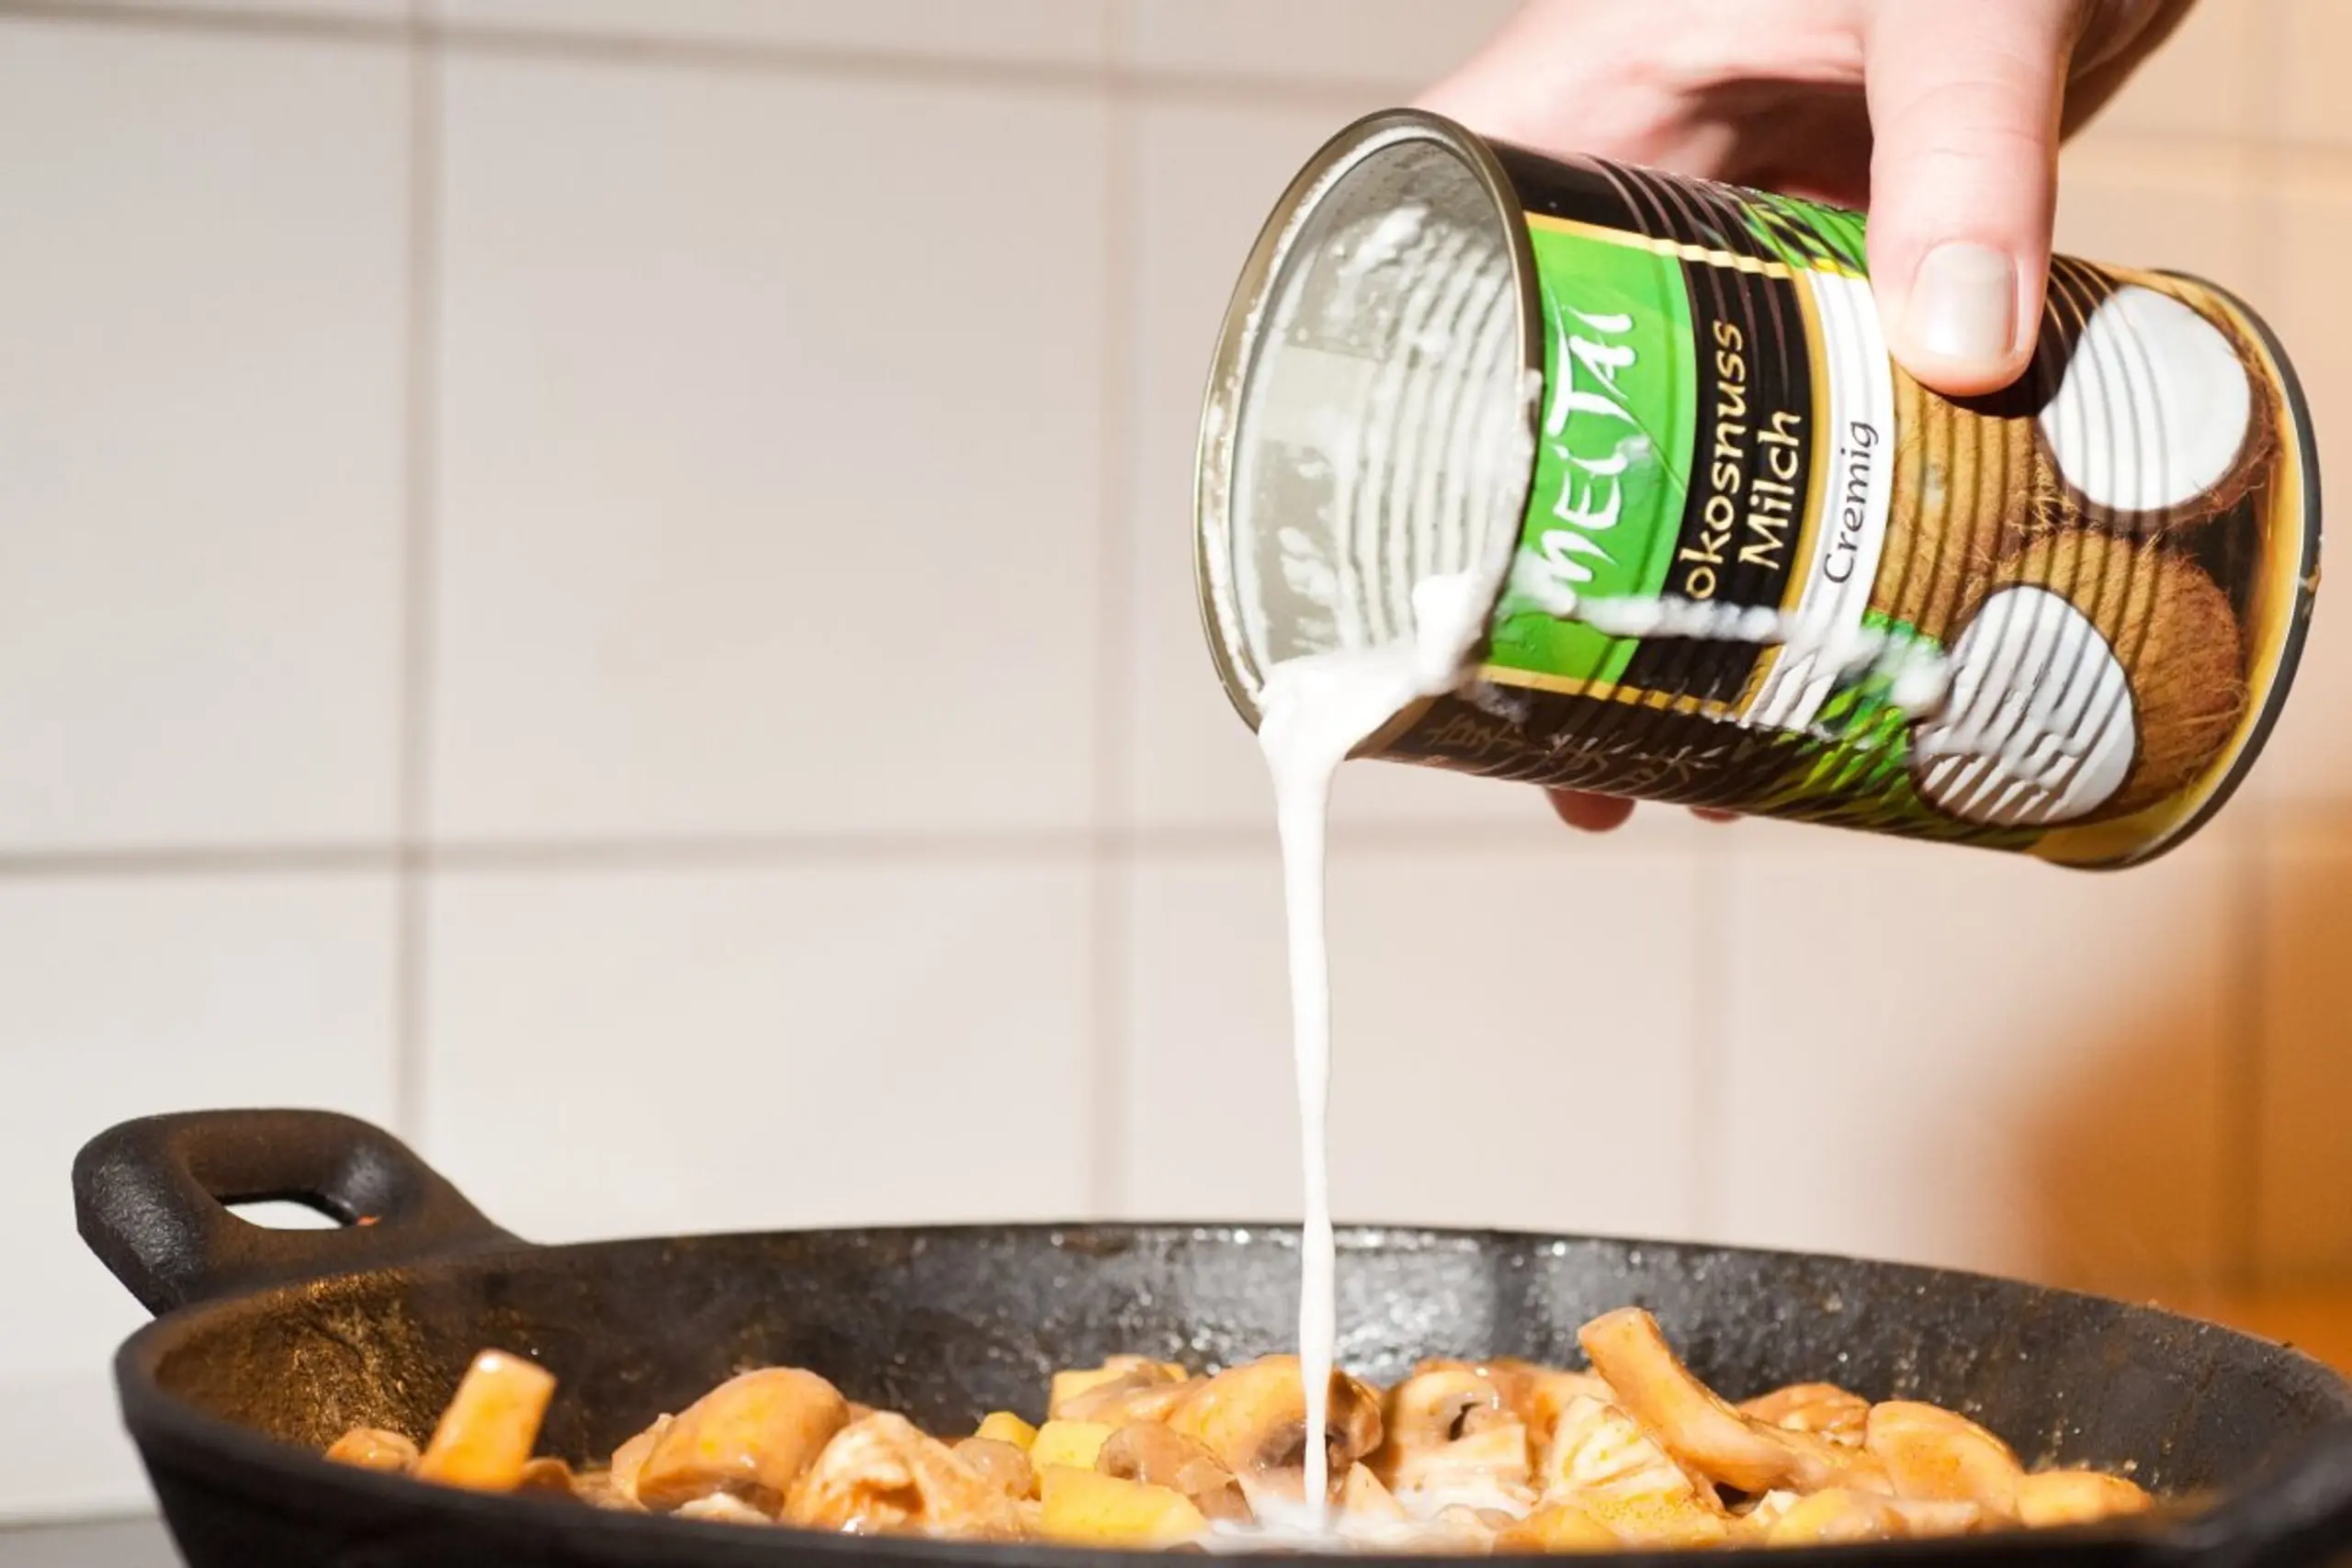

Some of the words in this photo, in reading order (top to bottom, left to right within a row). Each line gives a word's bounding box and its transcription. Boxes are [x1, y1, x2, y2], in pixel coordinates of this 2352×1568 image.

[1678, 320, 1747, 600] okosnuss
[1738, 411, 1802, 570] Milch
[1823, 422, 1880, 584] Cremig
